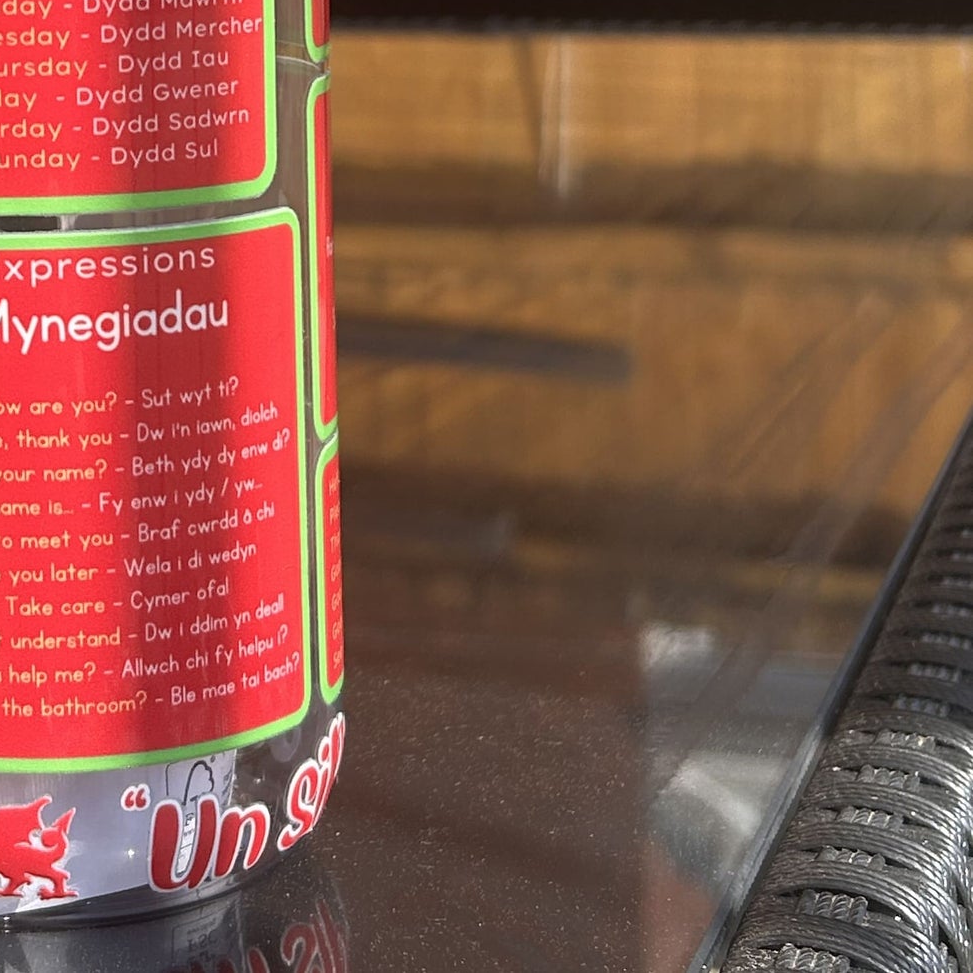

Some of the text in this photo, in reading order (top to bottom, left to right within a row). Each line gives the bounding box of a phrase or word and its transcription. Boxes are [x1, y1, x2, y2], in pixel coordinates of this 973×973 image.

[101, 21, 166, 47] Dydd
[176, 16, 262, 39] Mercher
[118, 51, 181, 77] Dydd
[192, 50, 228, 68] Iau
[76, 84, 143, 110] Dydd
[153, 80, 239, 101] Gwener
[93, 113, 158, 139] Dydd
[169, 109, 249, 131] Sadwrn
[111, 143, 175, 168] Dydd
[185, 138, 217, 159] Sul
[29, 402, 63, 415] are
[71, 391, 117, 419] you?
[142, 388, 172, 409] Sut
[180, 383, 211, 406] wyt
[217, 376, 239, 397] ti?
[16, 428, 70, 448] thank
[78, 433, 112, 451] you
[137, 422, 164, 442] Dw
[172, 422, 190, 438] i'n
[241, 401, 278, 426] diolch
[43, 458, 108, 482] name?
[132, 454, 174, 477] Beth
[181, 449, 211, 475] ydy
[218, 444, 236, 467] dy
[241, 442, 268, 459] enw
[272, 428, 290, 451] di?
[99, 492, 123, 516] Fy
[131, 495, 167, 510] enw
[185, 481, 215, 507] ydy
[21, 530, 71, 549] meet
[79, 533, 113, 552] you
[138, 518, 180, 543] Braf
[188, 508, 238, 536] cwrdd
[256, 501, 275, 521] chi
[8, 570, 43, 587] you
[50, 562, 99, 582] later
[123, 555, 171, 577] Wela
[188, 549, 202, 569] di
[208, 540, 256, 565] wedyn
[5, 596, 53, 616] Take
[61, 601, 105, 615] care
[131, 590, 190, 613] Cymer
[197, 576, 229, 601] ofal
[10, 626, 120, 650] understand
[145, 622, 172, 642] Dw
[190, 614, 228, 635] ddim
[233, 611, 251, 630] yn
[255, 593, 284, 620] deall
[9, 664, 47, 688] help
[55, 661, 96, 683] me?
[122, 654, 179, 679] Allwch
[185, 648, 209, 666] chi
[215, 644, 233, 666] fy
[238, 635, 274, 659] helpu
[1, 697, 33, 717] the
[41, 690, 147, 721] bathroom?
[171, 685, 196, 706] Ble
[203, 678, 235, 701] mae
[240, 671, 260, 690] tai
[264, 651, 300, 683] bach?
